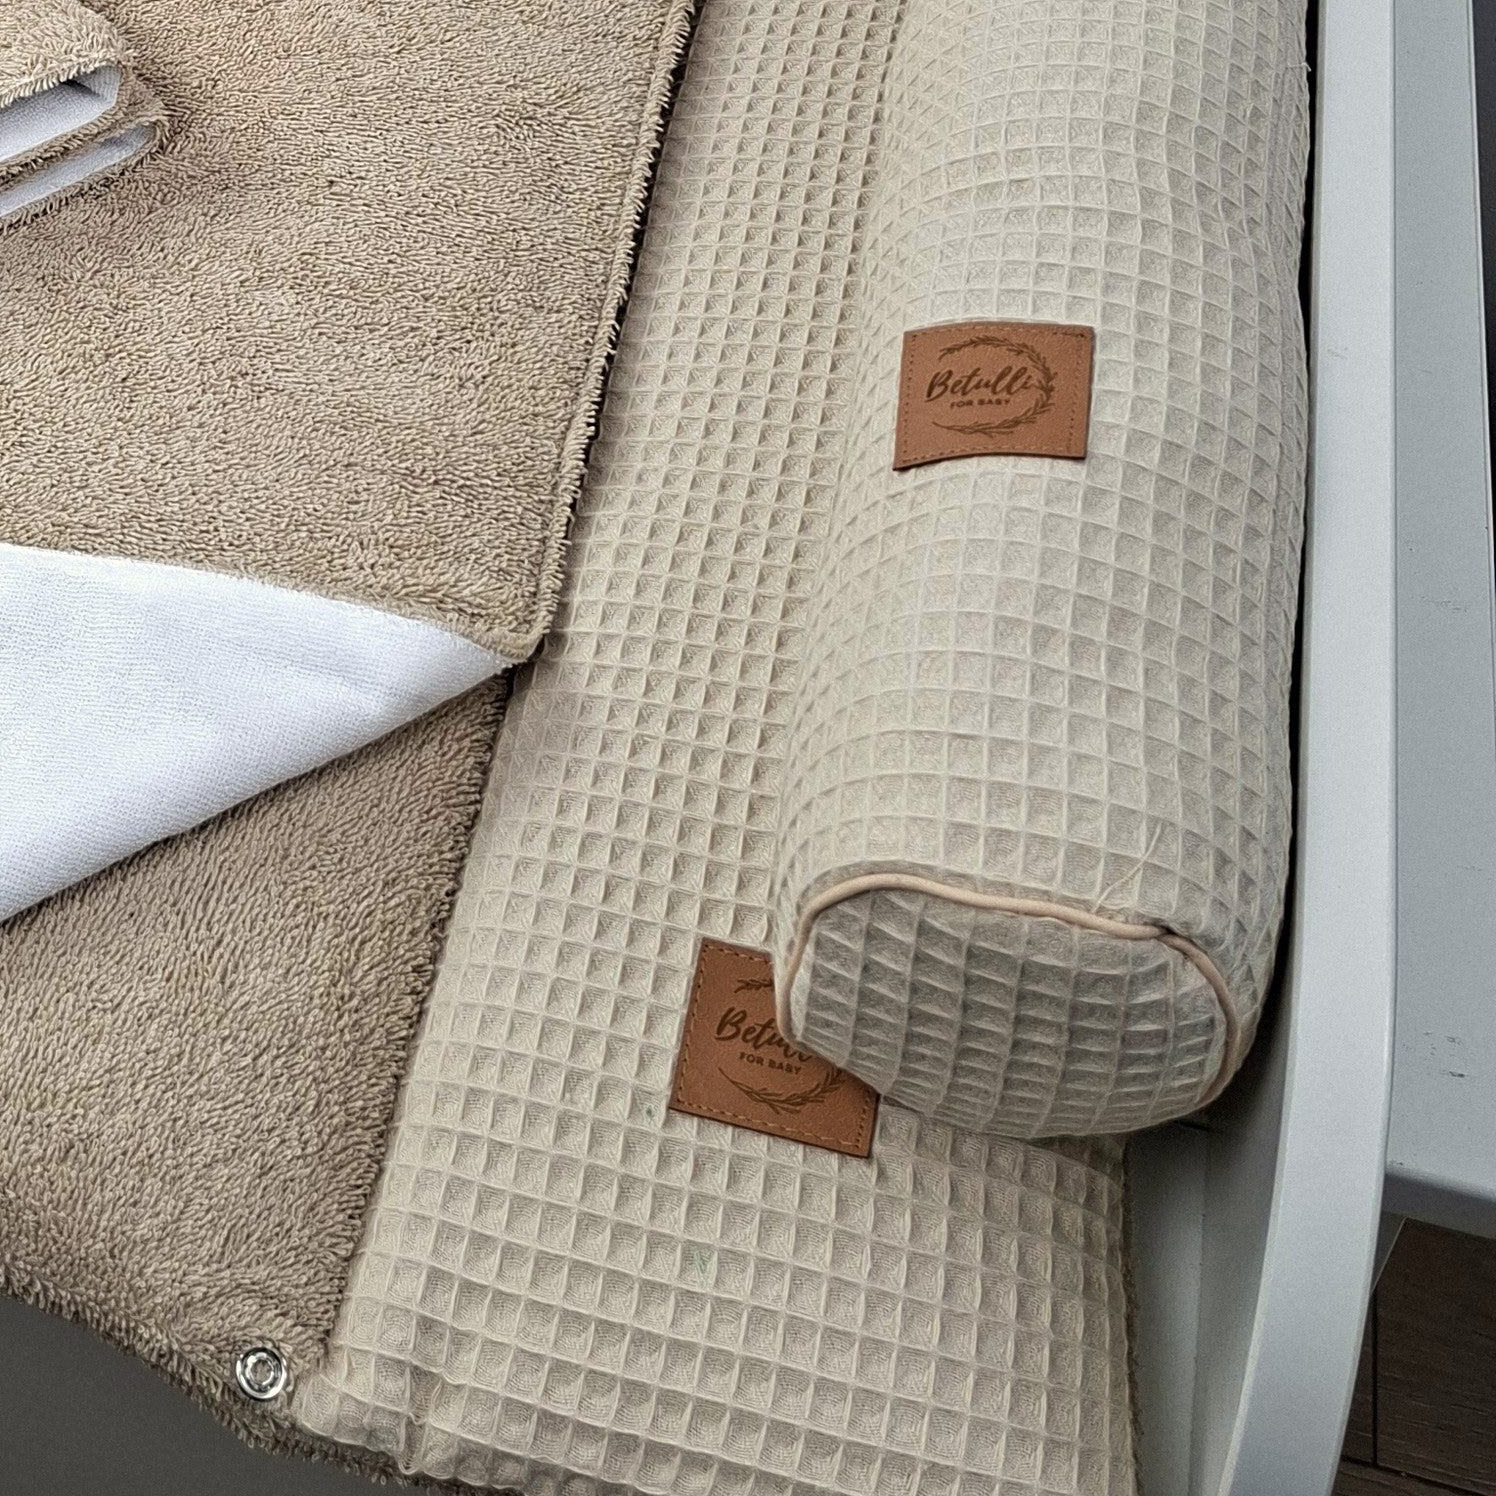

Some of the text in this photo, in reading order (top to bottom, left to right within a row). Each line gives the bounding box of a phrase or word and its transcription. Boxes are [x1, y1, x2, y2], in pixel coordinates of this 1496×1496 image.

[925, 365, 1033, 403] Betulli
[950, 398, 1010, 409] FOR BABY
[714, 1006, 813, 1062] Betu
[739, 1051, 802, 1075] FOR BABY
